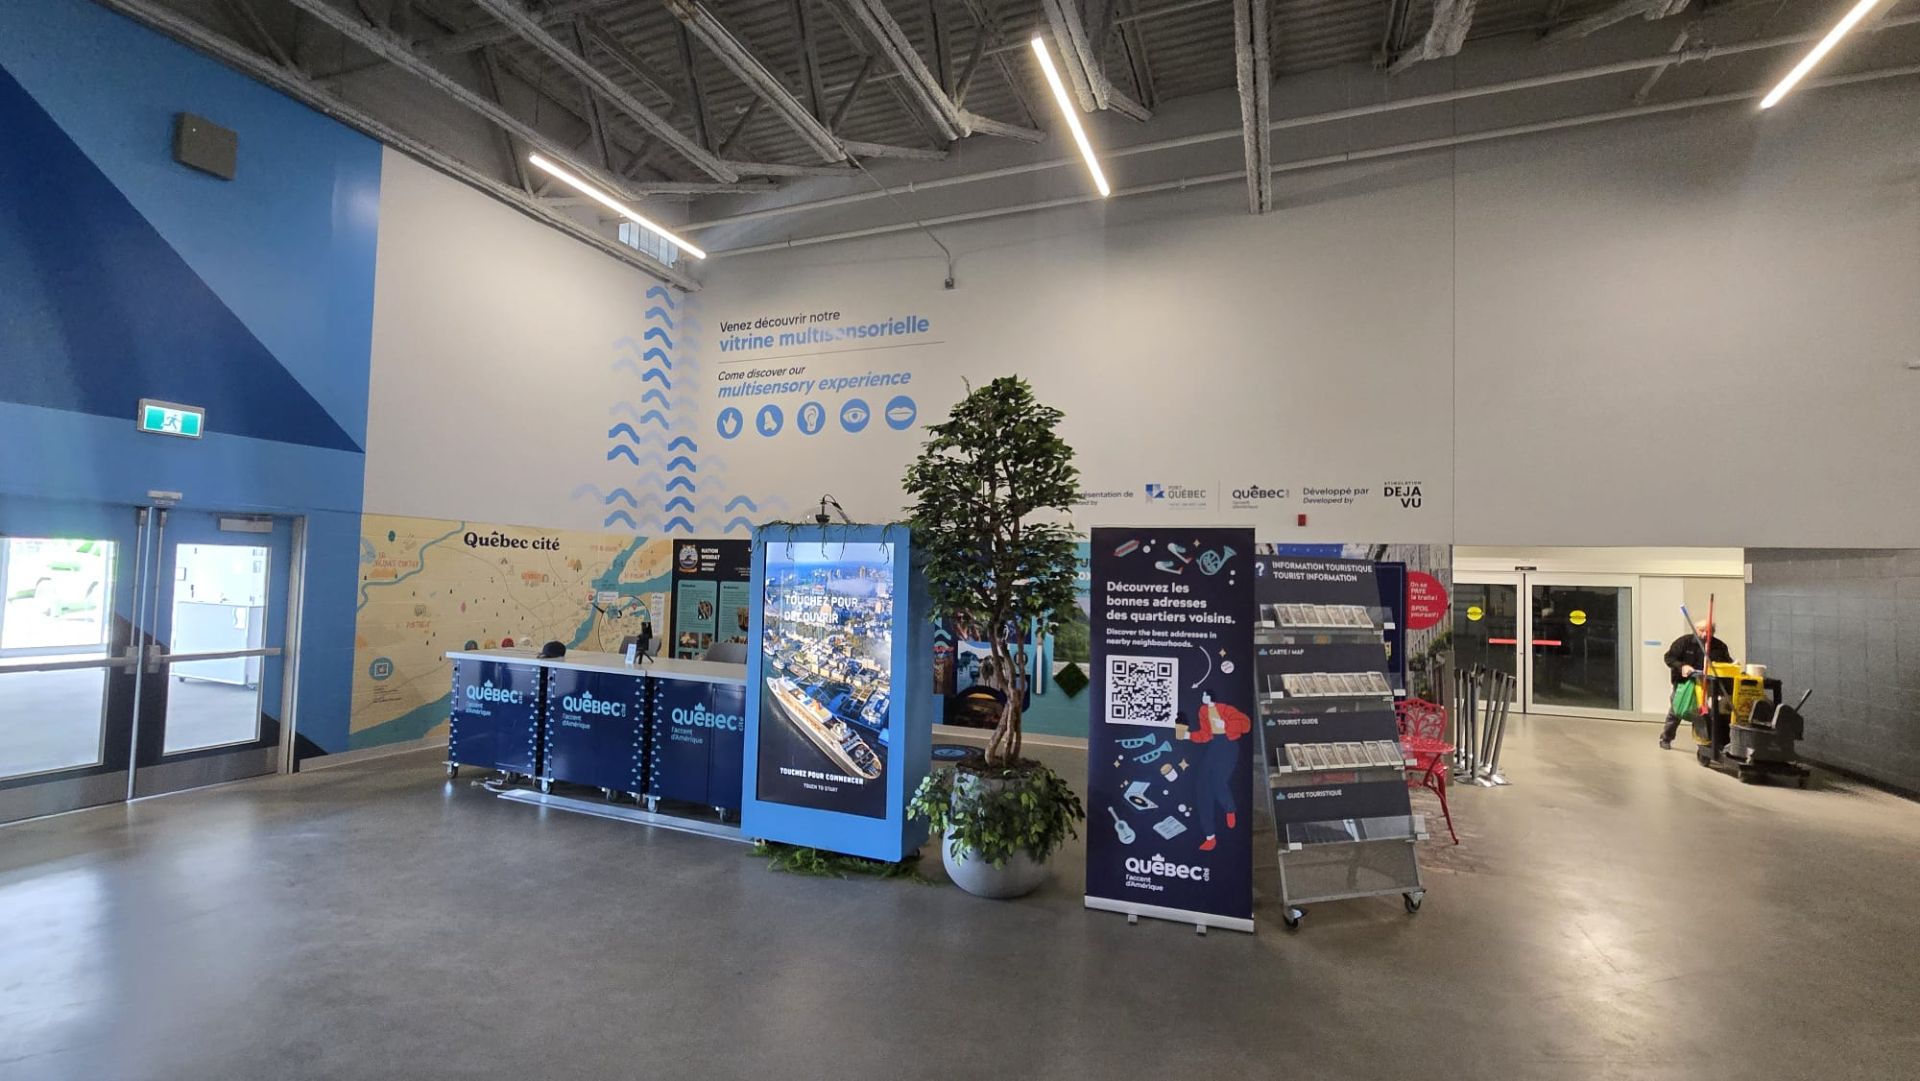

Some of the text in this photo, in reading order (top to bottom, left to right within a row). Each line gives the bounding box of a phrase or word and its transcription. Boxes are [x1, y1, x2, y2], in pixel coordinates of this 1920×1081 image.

[720, 310, 841, 333] Venez découvrir notre
[720, 315, 930, 352] vitrine multisensorielle
[718, 365, 806, 381] Come discover our
[718, 371, 912, 398] multisensory experience
[1123, 490, 1134, 498] de
[1168, 489, 1207, 500] QUÉBEC
[1303, 487, 1370, 496] Développé par
[1384, 486, 1422, 497] DEJA
[1400, 498, 1422, 508] VU
[464, 531, 560, 551] Québec cité
[1271, 561, 1373, 573] INFORMATION TOURISTIQUE
[1272, 571, 1358, 582] TOURIST INFORMATION
[1106, 581, 1190, 593] Découvrez les
[784, 594, 858, 608] TOUCHEZ POUR
[1106, 595, 1207, 608] bonnes adresses
[1106, 609, 1236, 624] des quartiers voisins.
[1106, 628, 1137, 636] Discover
[1152, 629, 1169, 637] best
[1170, 630, 1208, 638] addresses
[1209, 631, 1217, 639] in
[1106, 638, 1193, 647] nearby neighbourhoods.
[1277, 718, 1300, 726] TOURIST
[780, 767, 807, 778] TOUCHEZ
[807, 771, 825, 780] POUR
[1306, 789, 1342, 798] TOURISTIQUE
[1125, 874, 1152, 883] l'accent
[1125, 881, 1164, 891] d'Amérique
